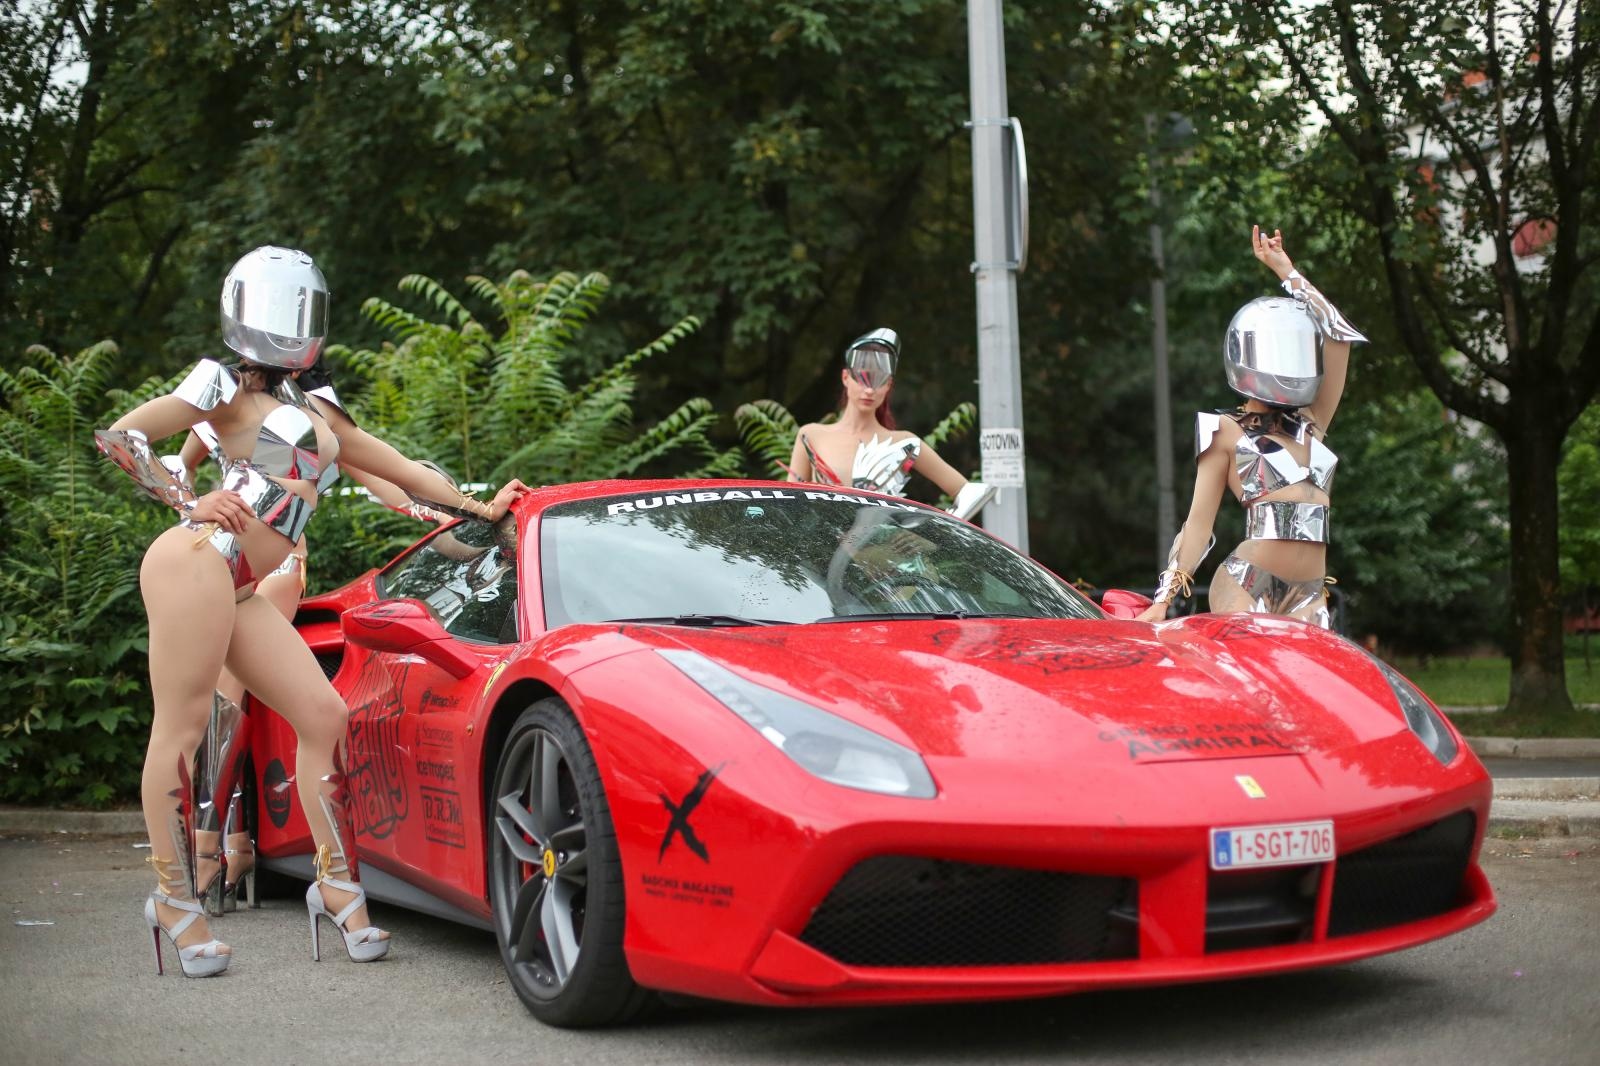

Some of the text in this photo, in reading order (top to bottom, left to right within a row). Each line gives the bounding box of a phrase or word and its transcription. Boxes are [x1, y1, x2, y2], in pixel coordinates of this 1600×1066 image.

[607, 490, 919, 516] RUNBALL RALLY
[1128, 732, 1297, 760] ADMIRAL
[1218, 850, 1228, 863] B
[1234, 828, 1332, 861] 1-SGT-706
[682, 881, 735, 897] MAGAZINE
